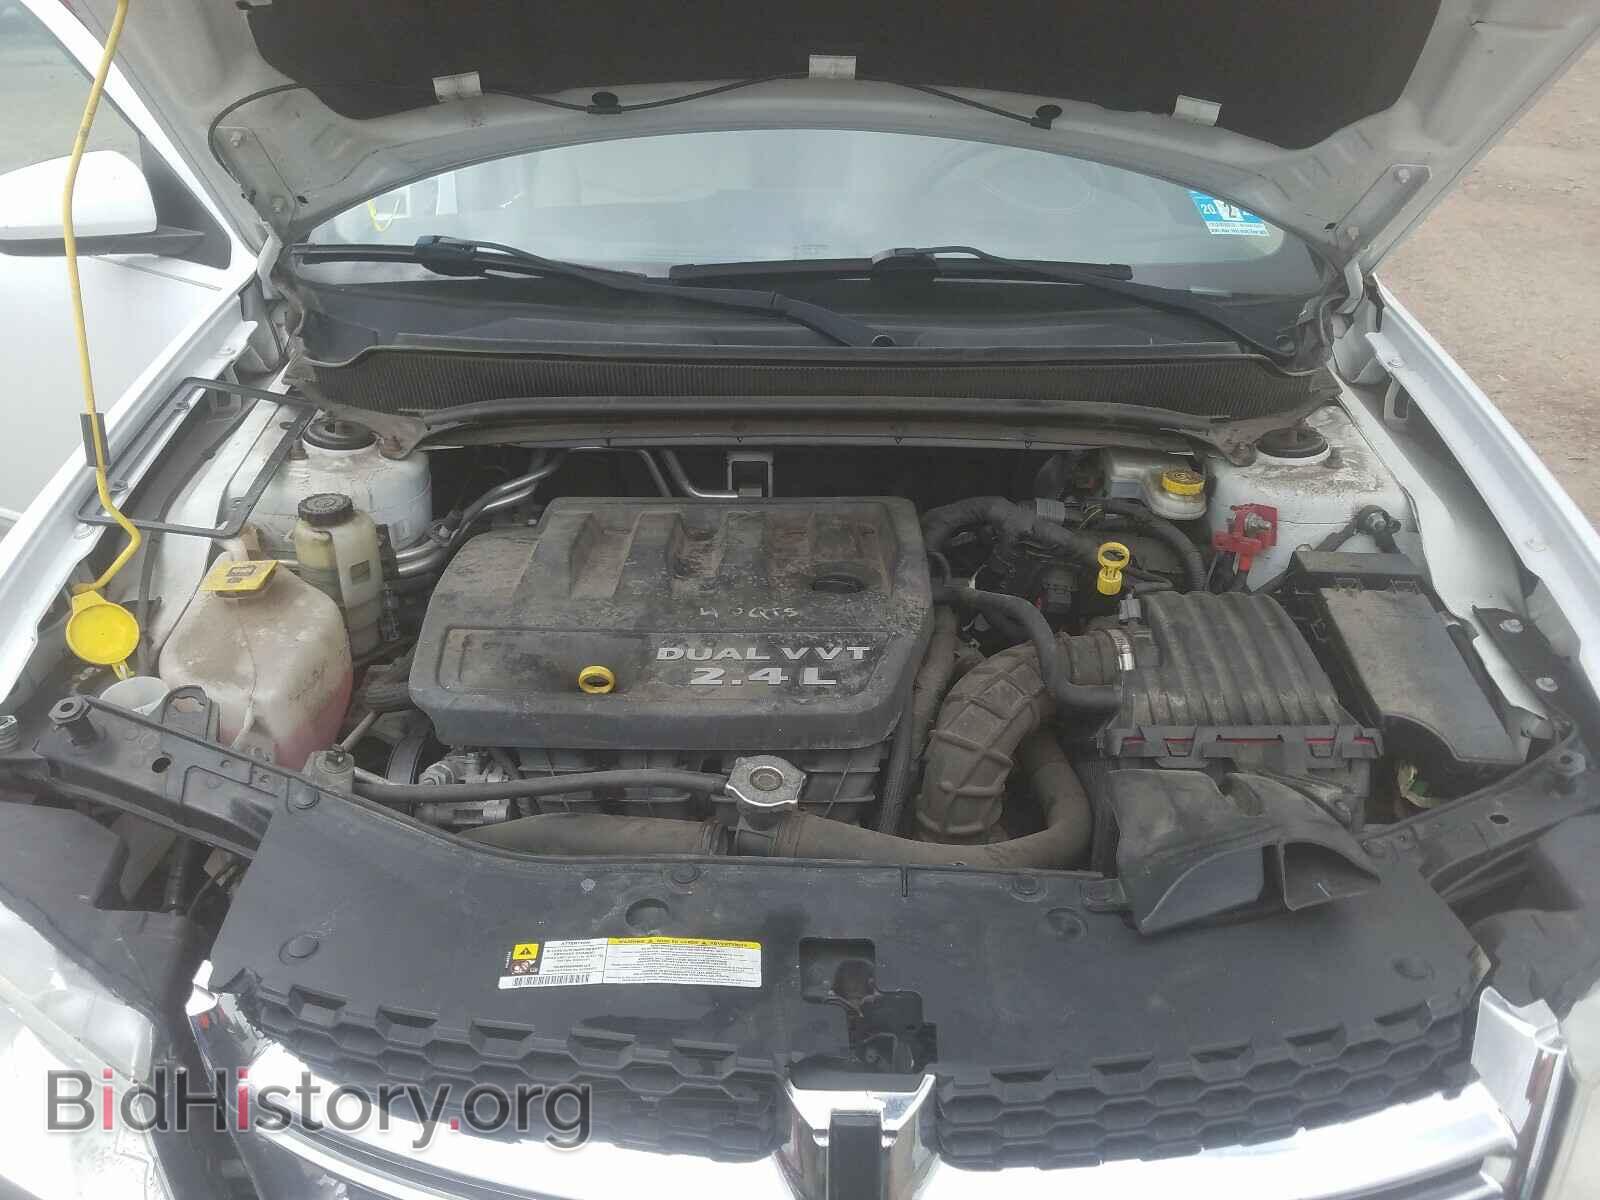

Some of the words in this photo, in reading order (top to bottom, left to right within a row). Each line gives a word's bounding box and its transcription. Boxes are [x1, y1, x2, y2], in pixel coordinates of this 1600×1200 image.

[1201, 204, 1216, 214] 20
[656, 647, 770, 661] DUAL
[781, 646, 871, 660] VVT
